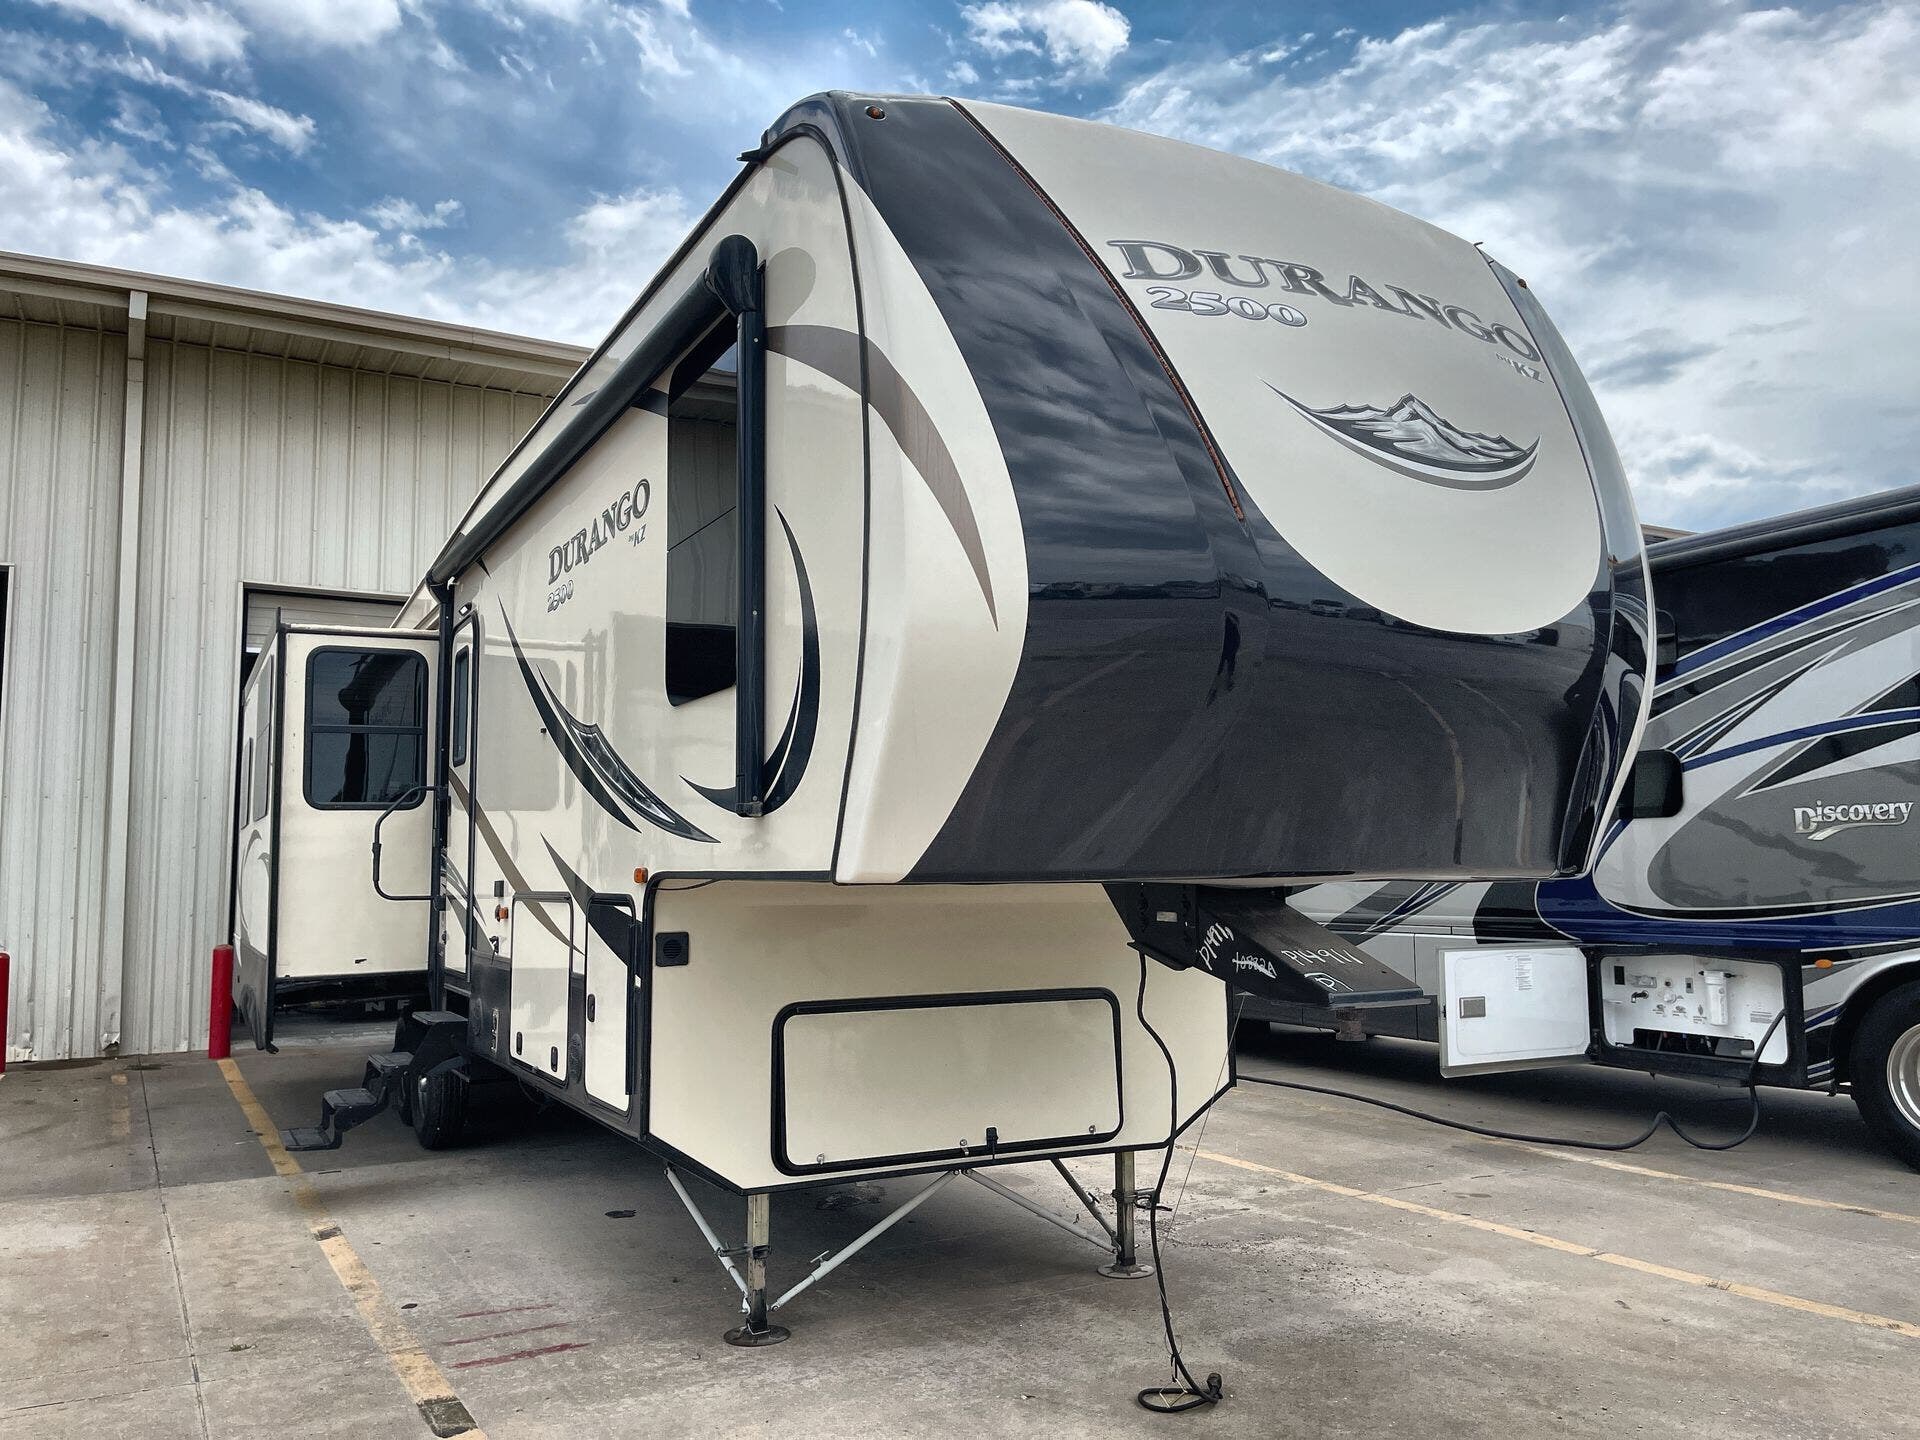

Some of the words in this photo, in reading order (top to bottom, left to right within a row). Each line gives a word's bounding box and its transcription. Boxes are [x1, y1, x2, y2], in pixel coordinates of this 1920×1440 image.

[1106, 239, 1541, 362] DURANGO
[1146, 285, 1308, 328] 2500
[1511, 360, 1545, 384] KZ
[548, 478, 651, 585] DURANGO
[547, 579, 574, 613] 2500
[1793, 799, 1914, 838] Discovery
